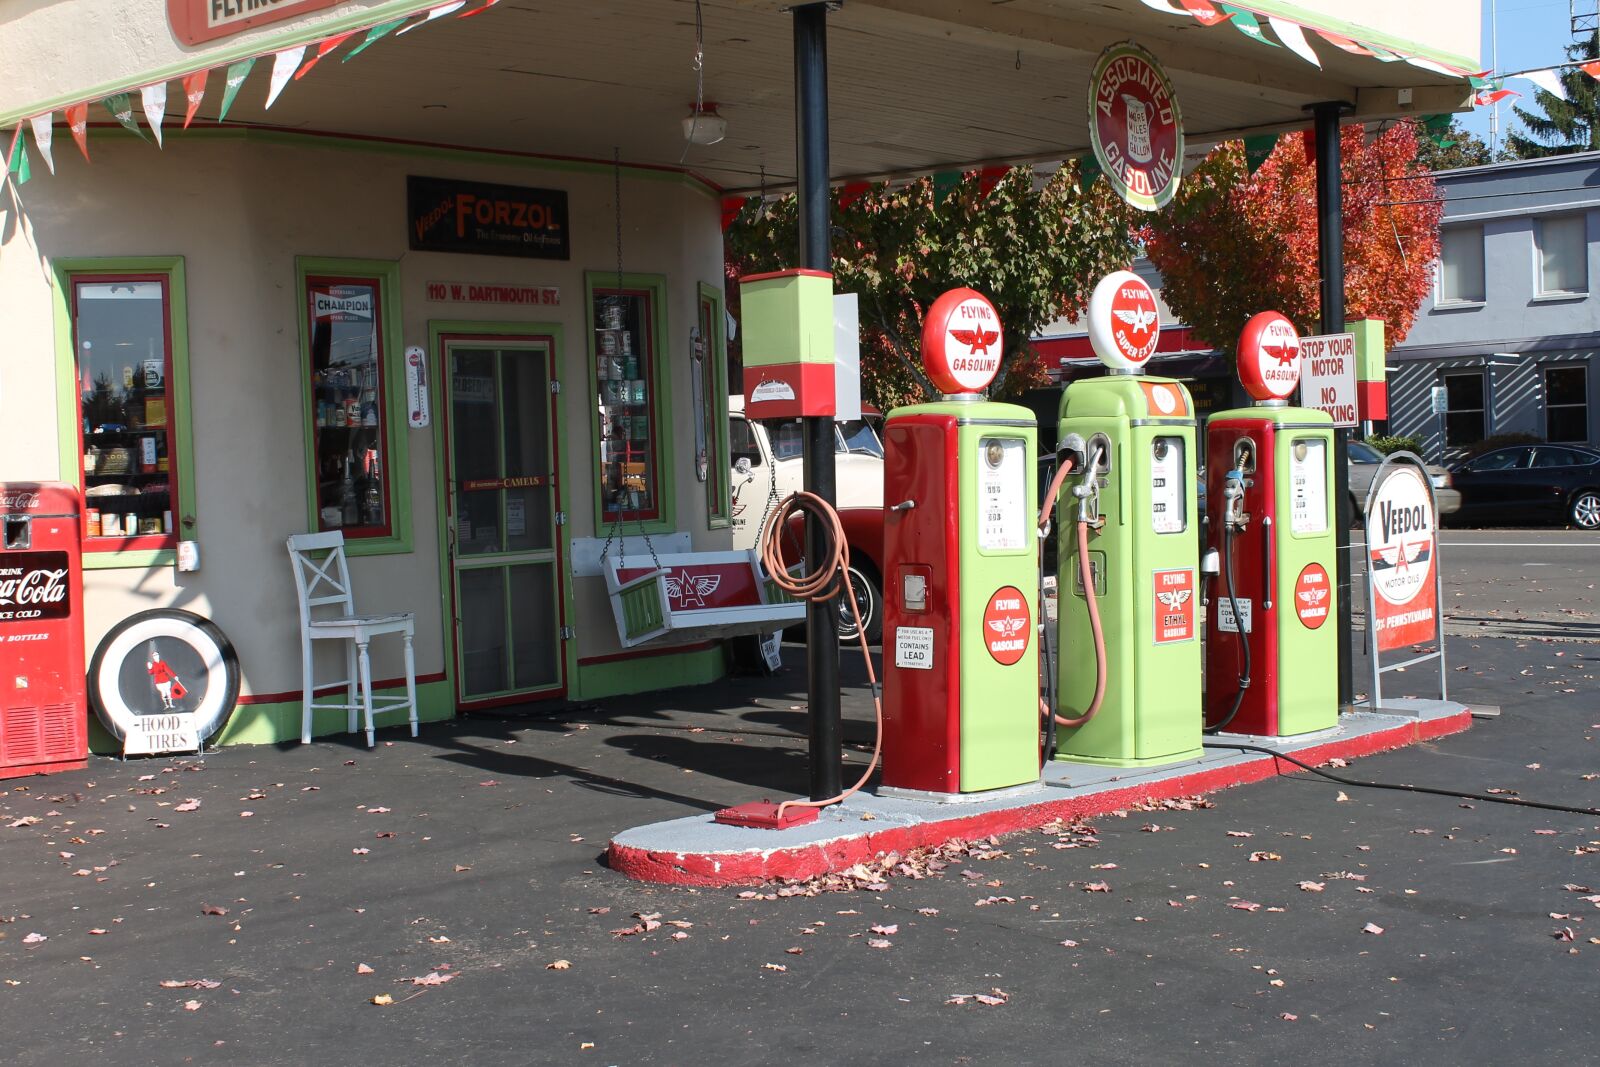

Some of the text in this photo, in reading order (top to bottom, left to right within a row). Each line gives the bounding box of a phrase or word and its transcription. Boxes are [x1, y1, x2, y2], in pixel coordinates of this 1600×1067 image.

[212, 0, 280, 20] FLY
[1098, 58, 1174, 125] ASSOCIATED
[1129, 109, 1145, 121] MORE
[1129, 121, 1147, 134] MILES
[1130, 142, 1151, 157] GALLON
[1105, 141, 1174, 194] GASOLINE
[456, 194, 560, 238] FORZOL
[428, 284, 560, 305] 110 W. DARTMOUTH ST.
[1121, 288, 1150, 300] FLYING
[318, 300, 368, 311] CHAMPION
[961, 306, 991, 319] FLYING
[1270, 325, 1293, 337] FLYING
[1116, 330, 1157, 358] SUPER EXTRA
[1301, 338, 1353, 359] STOP YOUR
[953, 359, 996, 372] GASOLINE
[1312, 358, 1344, 376] MOTOR
[1265, 369, 1297, 381] GASOLINE
[1321, 387, 1336, 404] NO
[1307, 404, 1355, 422] KING
[1380, 500, 1427, 543] VEEDOL
[1163, 573, 1186, 585] FLYING
[1303, 573, 1323, 584] FLYING
[1385, 574, 1420, 589] MOTOR OILS
[995, 599, 1020, 611] FLYING
[16, 610, 41, 618] COLD
[1301, 607, 1326, 618] GASOLINE
[1386, 608, 1432, 629] PENNSYLVANIA
[1164, 614, 1186, 626] ETHYL
[7, 633, 49, 641] BOTTLES
[1164, 627, 1187, 638] GASOLINE
[900, 642, 929, 650] CONTAINS
[991, 639, 1024, 652] GASOLINE
[904, 651, 925, 660] LEAD
[147, 733, 187, 749] TIRES
